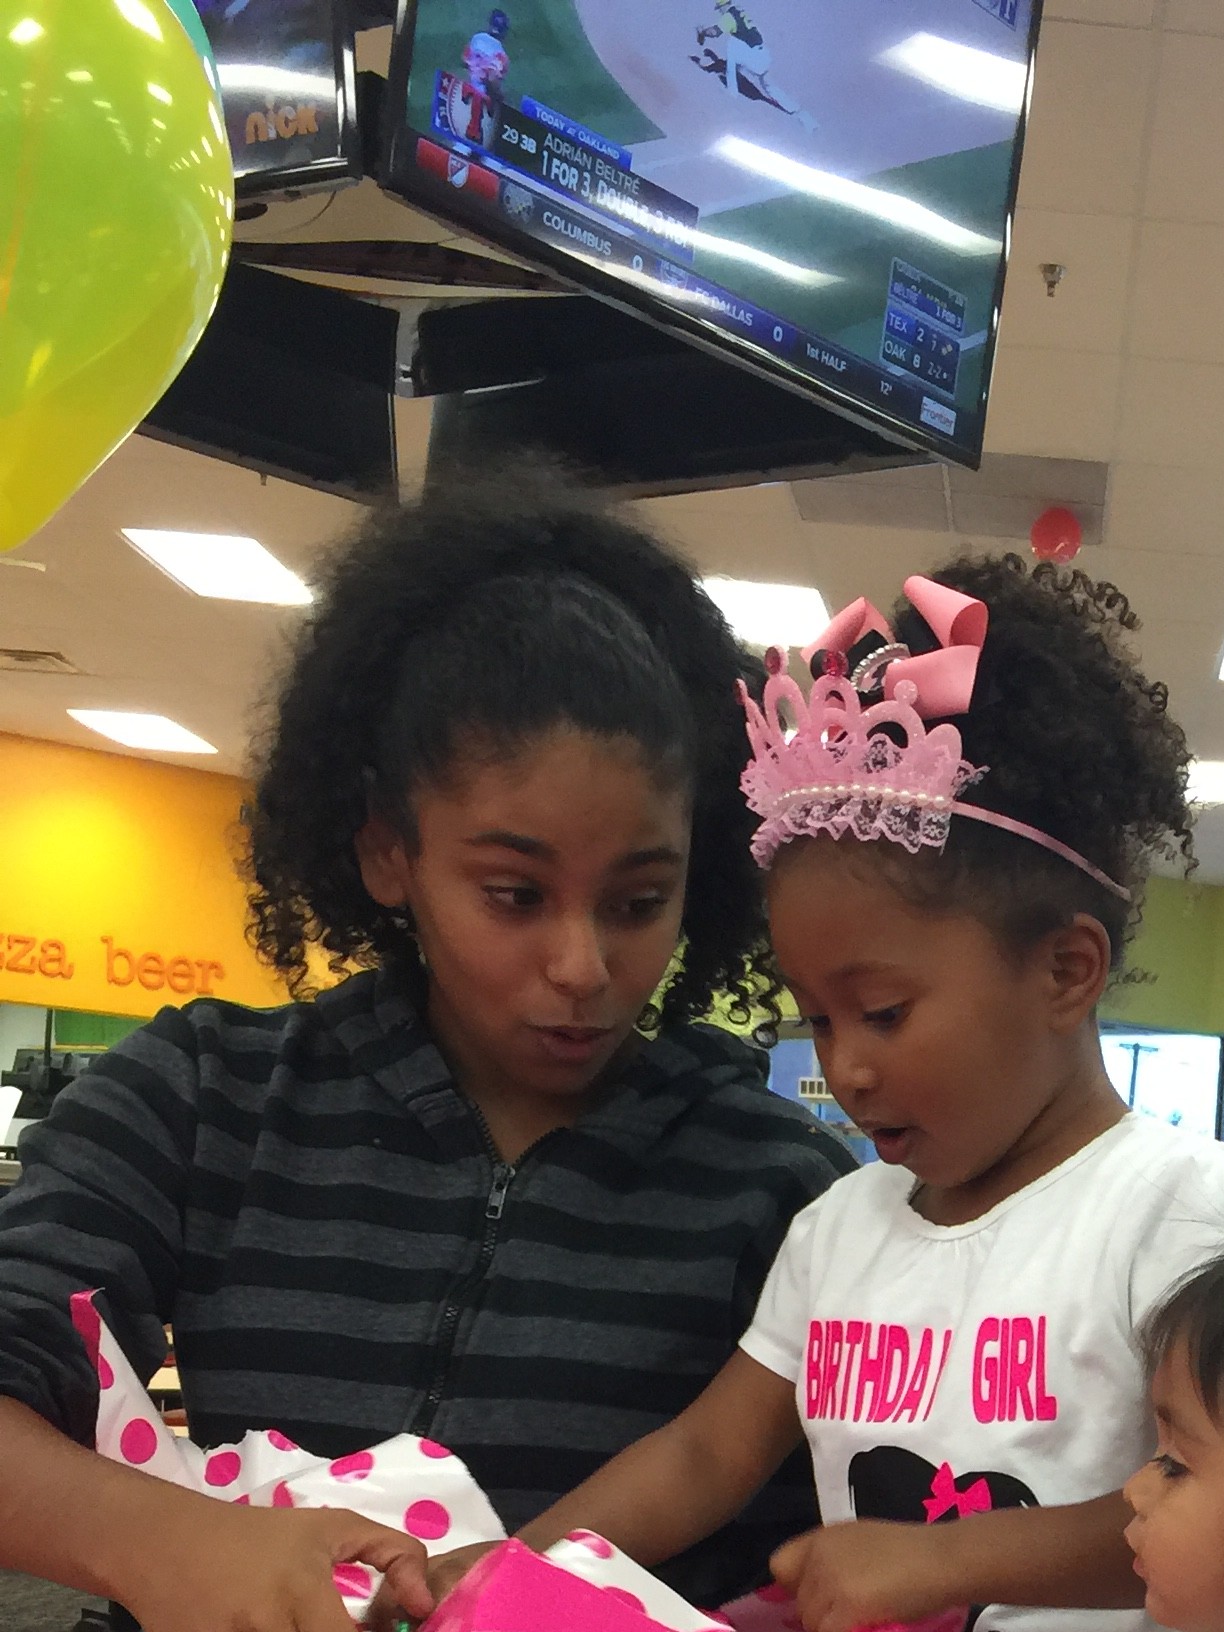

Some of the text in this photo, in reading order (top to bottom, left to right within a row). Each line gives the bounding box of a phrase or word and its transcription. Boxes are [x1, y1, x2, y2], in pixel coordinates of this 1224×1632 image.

[502, 124, 519, 145] 29
[535, 107, 565, 131] TODAY
[578, 130, 620, 160] OAKLAND
[541, 150, 548, 176] 1
[551, 158, 578, 190] FOR
[542, 210, 612, 256] COLUMBUS
[772, 325, 783, 342] 0
[888, 311, 908, 334] TEX
[915, 327, 924, 343] 2
[806, 342, 847, 373] 1st HALF
[884, 339, 906, 362] OAK
[912, 354, 921, 368] 8
[100, 934, 226, 995] beer
[972, 1314, 1058, 1425] GIRL
